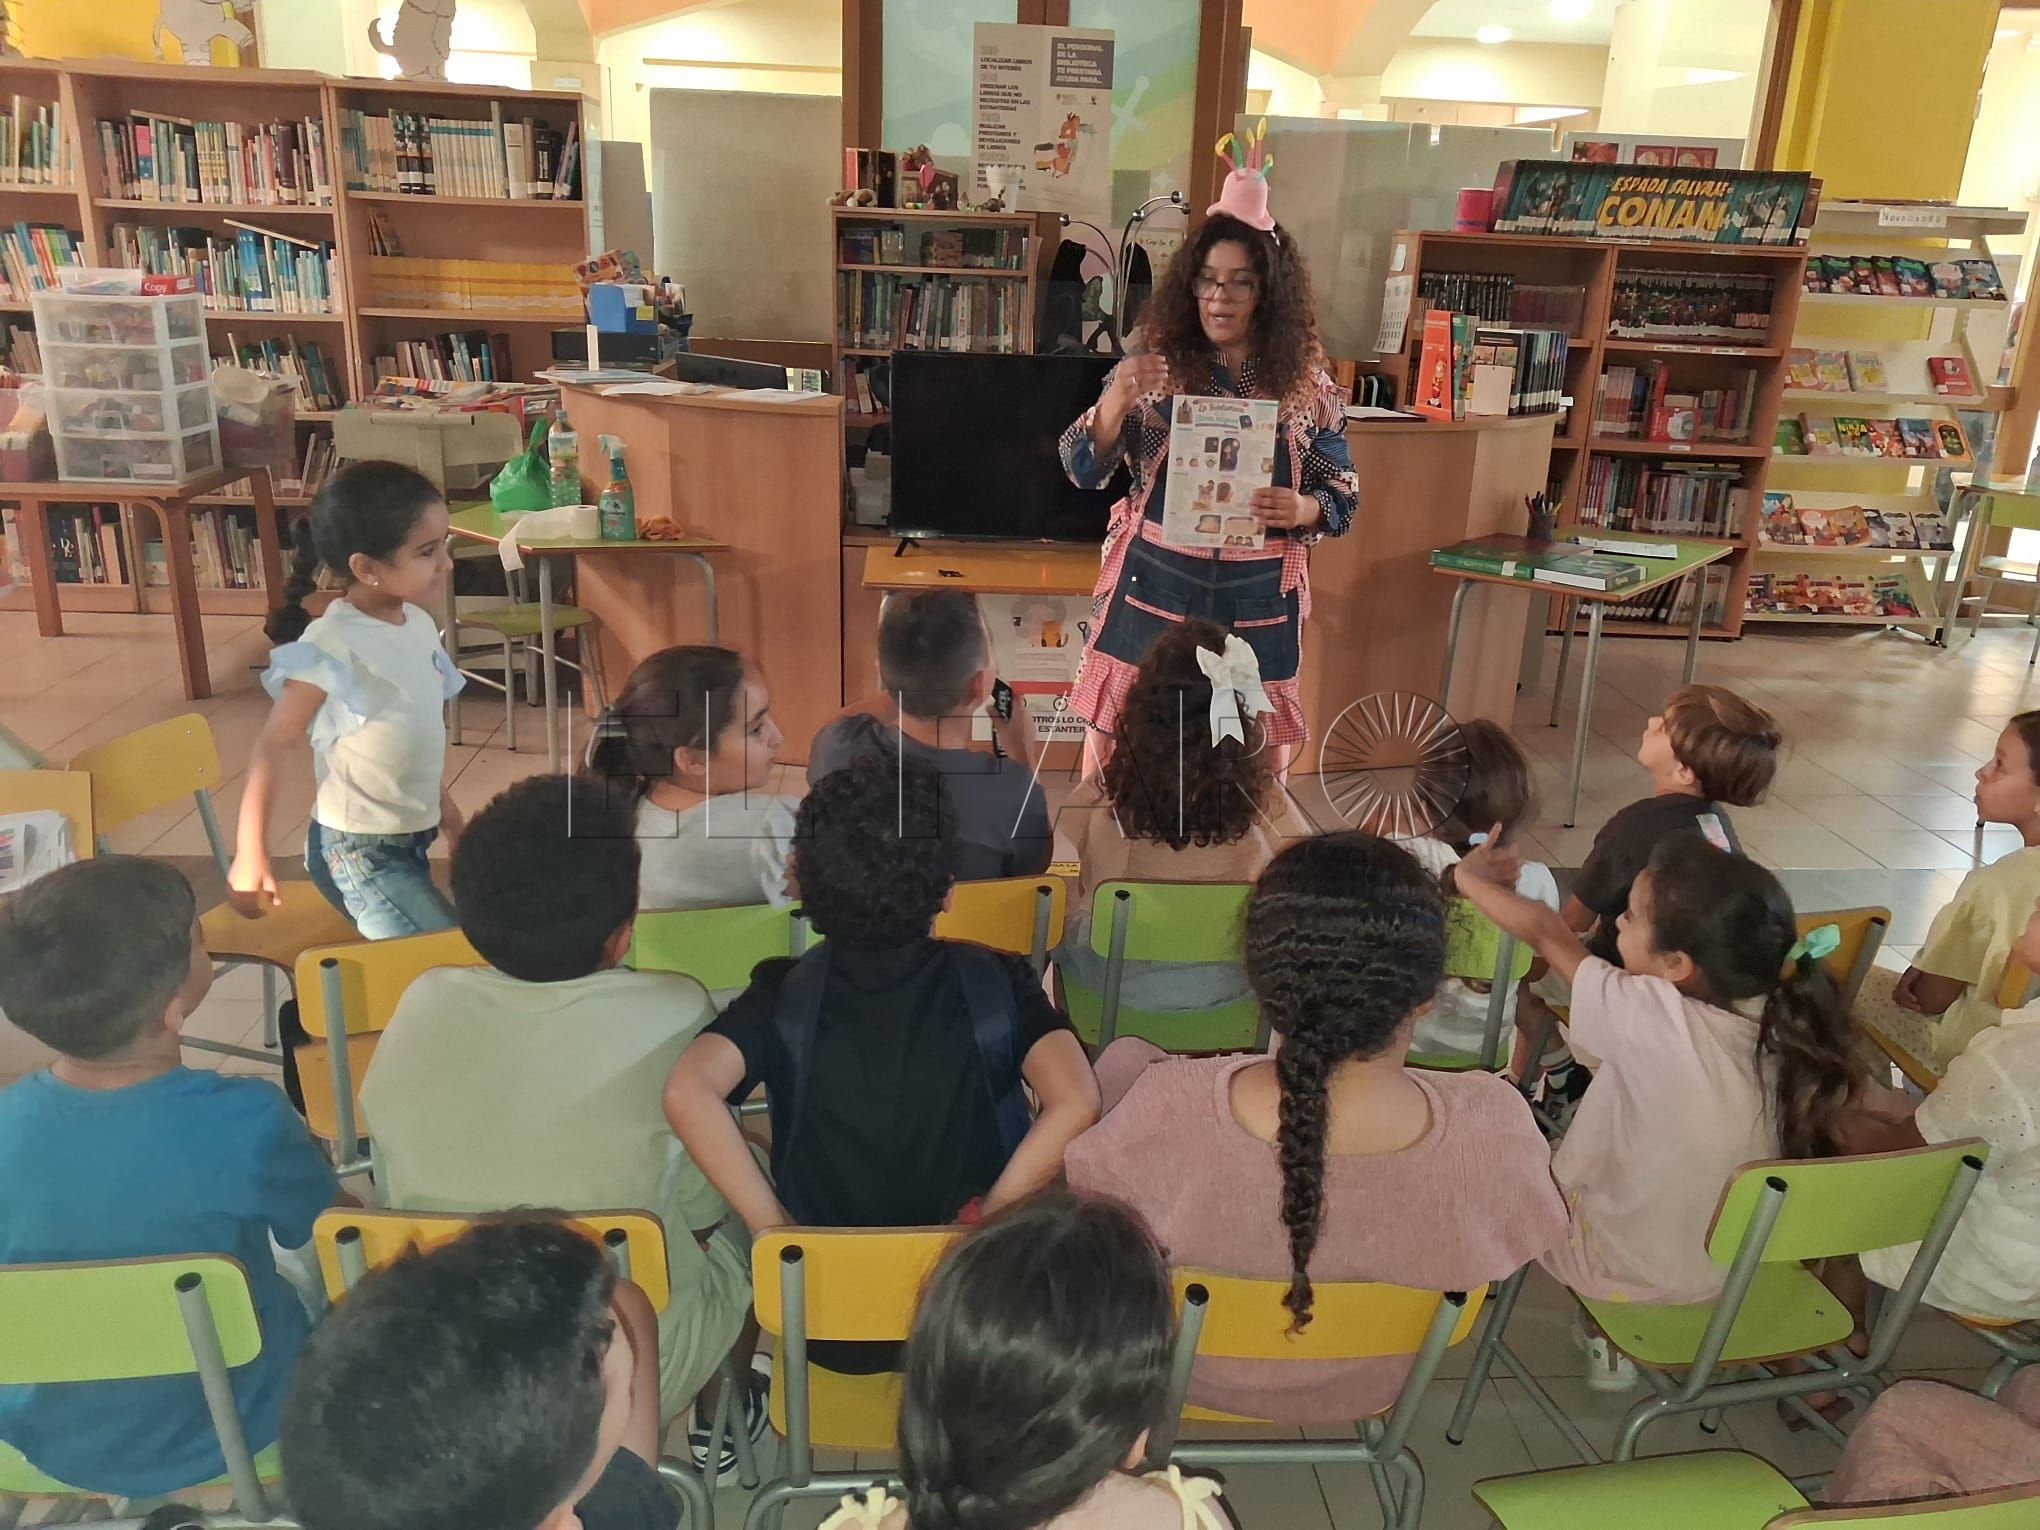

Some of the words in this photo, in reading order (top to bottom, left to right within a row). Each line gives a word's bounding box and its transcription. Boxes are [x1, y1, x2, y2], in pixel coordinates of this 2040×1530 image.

[1610, 176, 1669, 194] ESPADA
[1598, 196, 1729, 232] CONAN
[144, 282, 168, 293] Copy
[1062, 716, 1075, 724] LO
